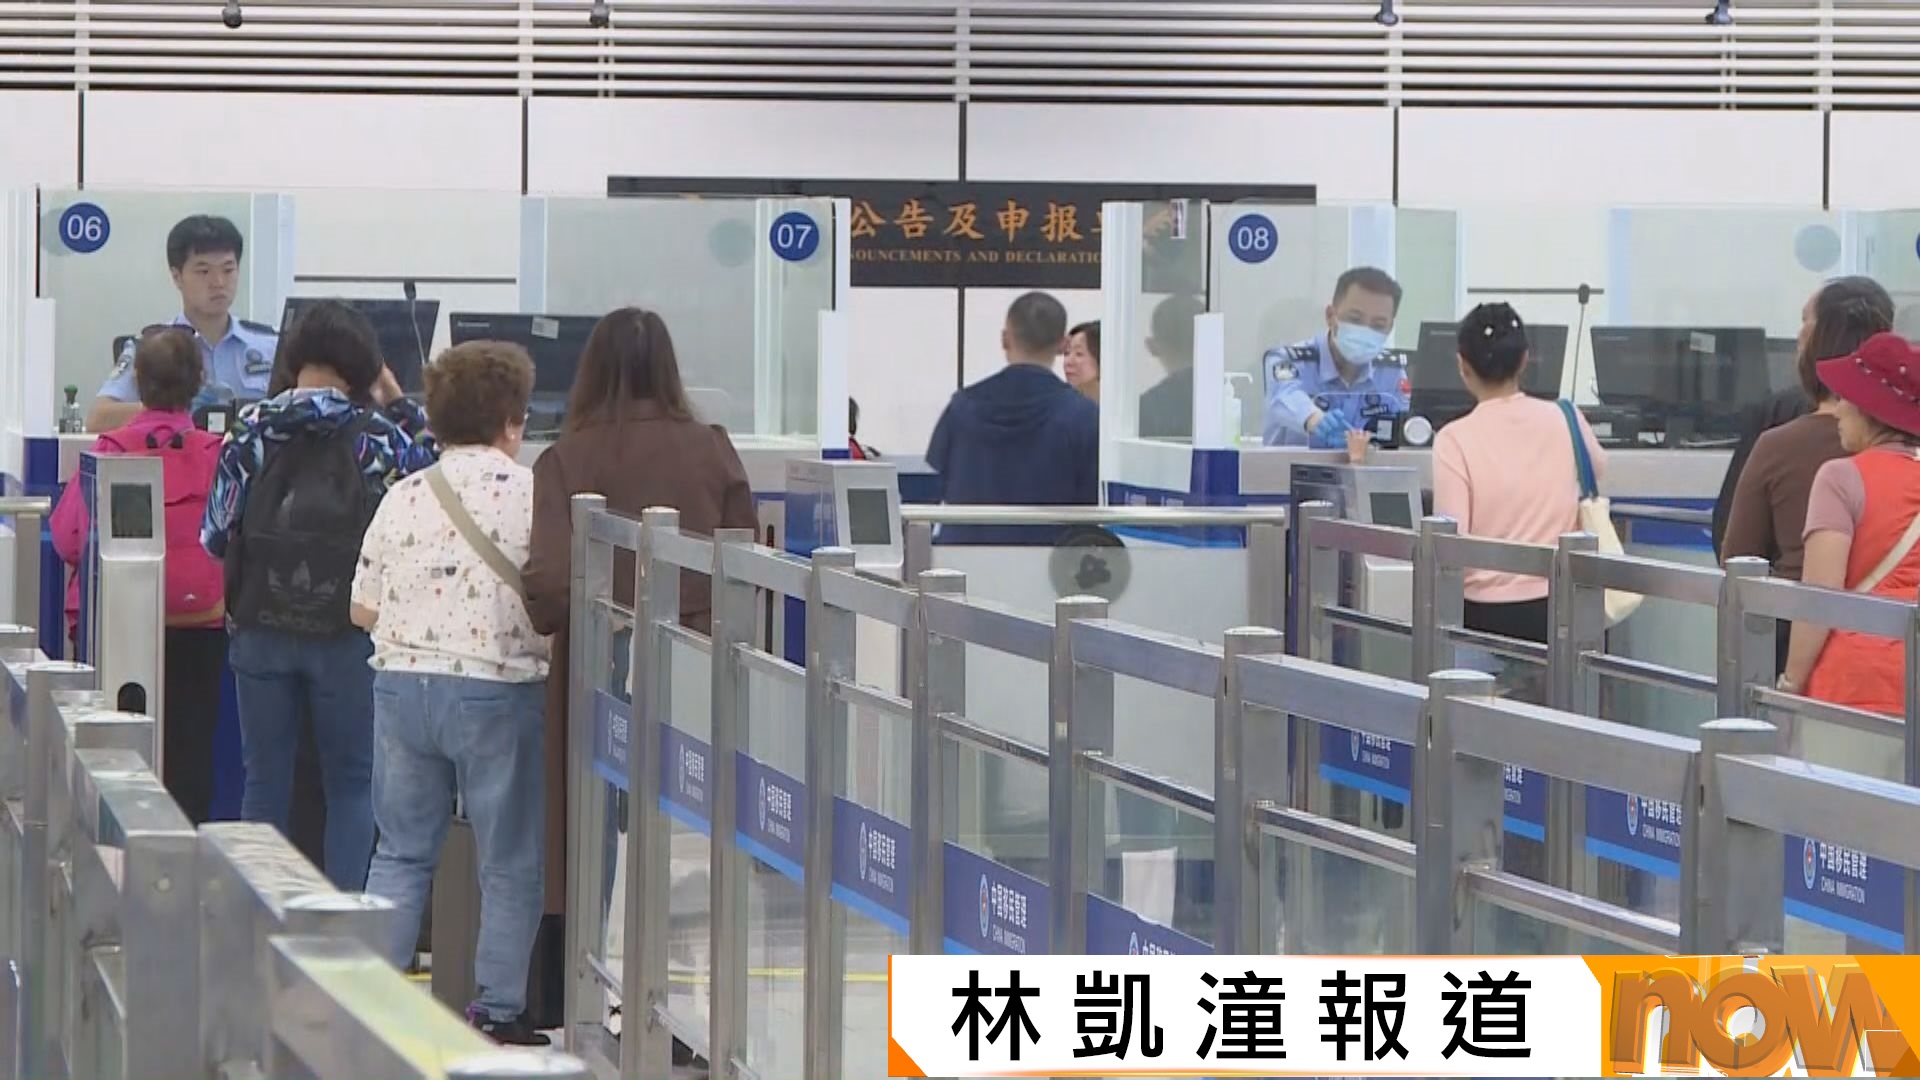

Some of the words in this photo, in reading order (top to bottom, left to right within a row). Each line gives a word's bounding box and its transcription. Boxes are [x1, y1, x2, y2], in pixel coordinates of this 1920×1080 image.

[67, 214, 102, 241] 06
[777, 223, 812, 249] 07
[1237, 226, 1269, 251] 08
[967, 250, 999, 262] AND
[1820, 876, 1835, 895] CHINA
[1836, 880, 1865, 904] IMMIGRATION
